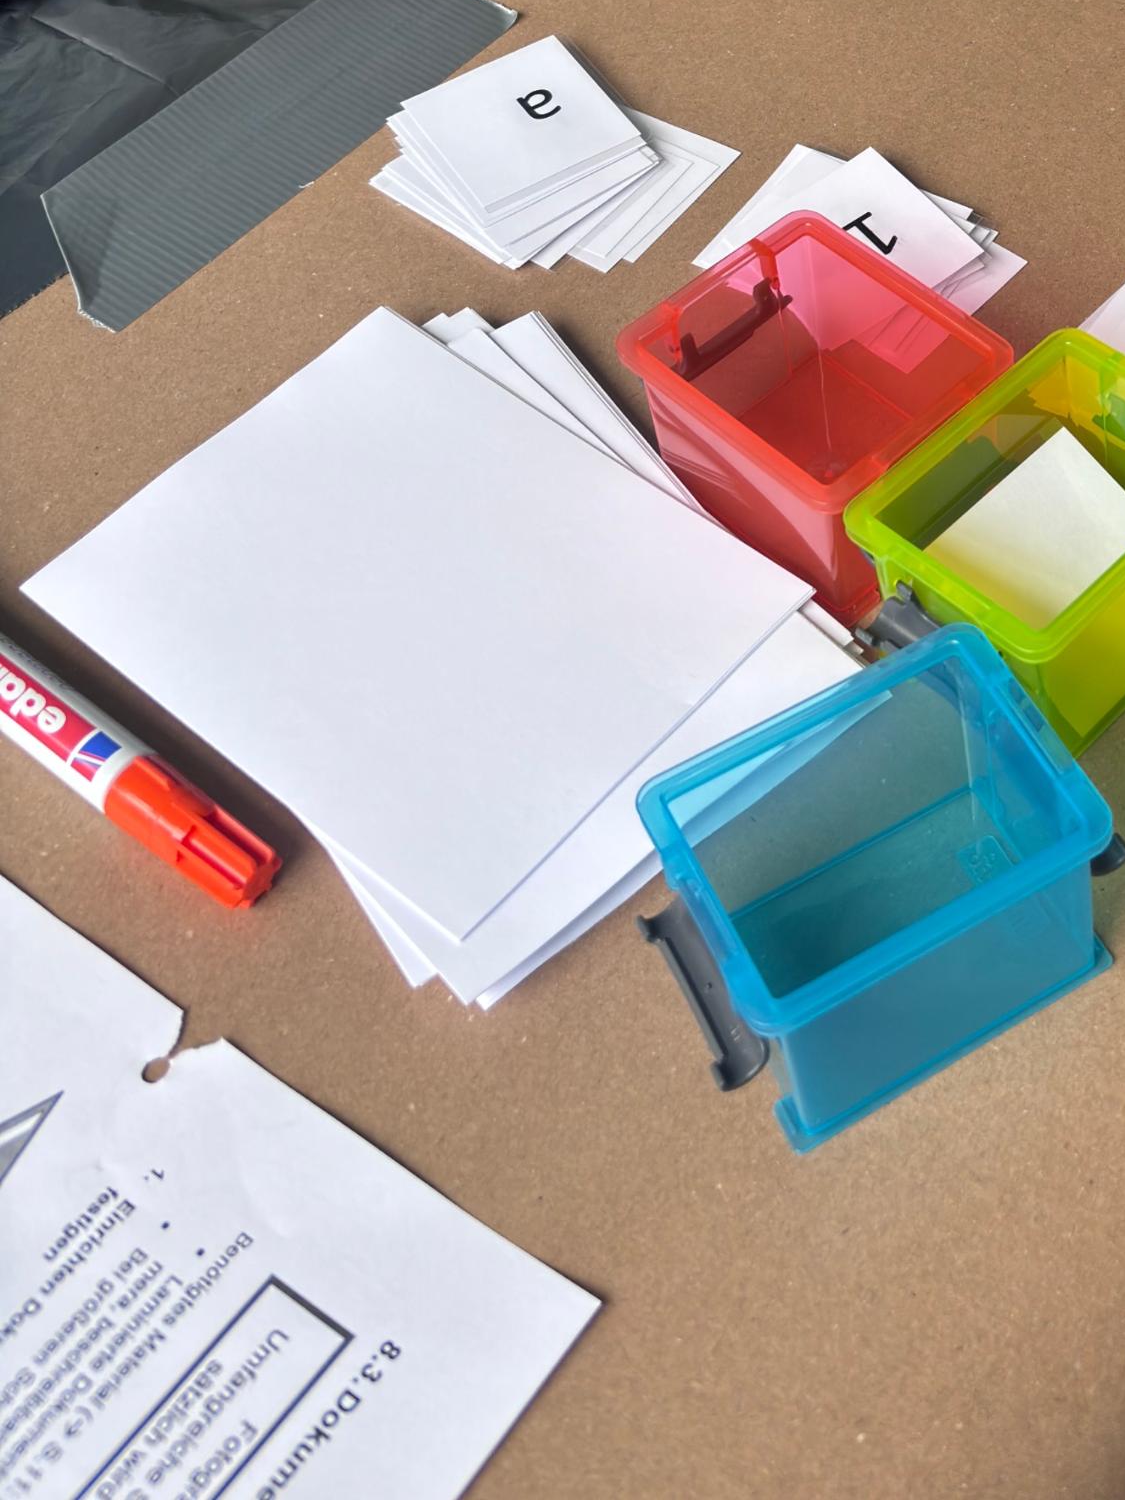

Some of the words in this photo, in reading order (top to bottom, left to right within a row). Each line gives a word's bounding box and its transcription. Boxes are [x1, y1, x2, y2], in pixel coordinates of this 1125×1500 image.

[516, 87, 562, 122] a
[842, 209, 900, 257] 1
[39, 1199, 136, 1296] Einrichten
[43, 1186, 119, 1263] festigen
[110, 1260, 164, 1312] mera,
[113, 1247, 149, 1280] Bei
[162, 1232, 254, 1326] Benötigtes
[89, 1274, 185, 1373] Laminierte
[352, 1339, 401, 1385] 8.3.
[90, 1330, 166, 1409] Material
[147, 1328, 290, 1485] Umfangreiche
